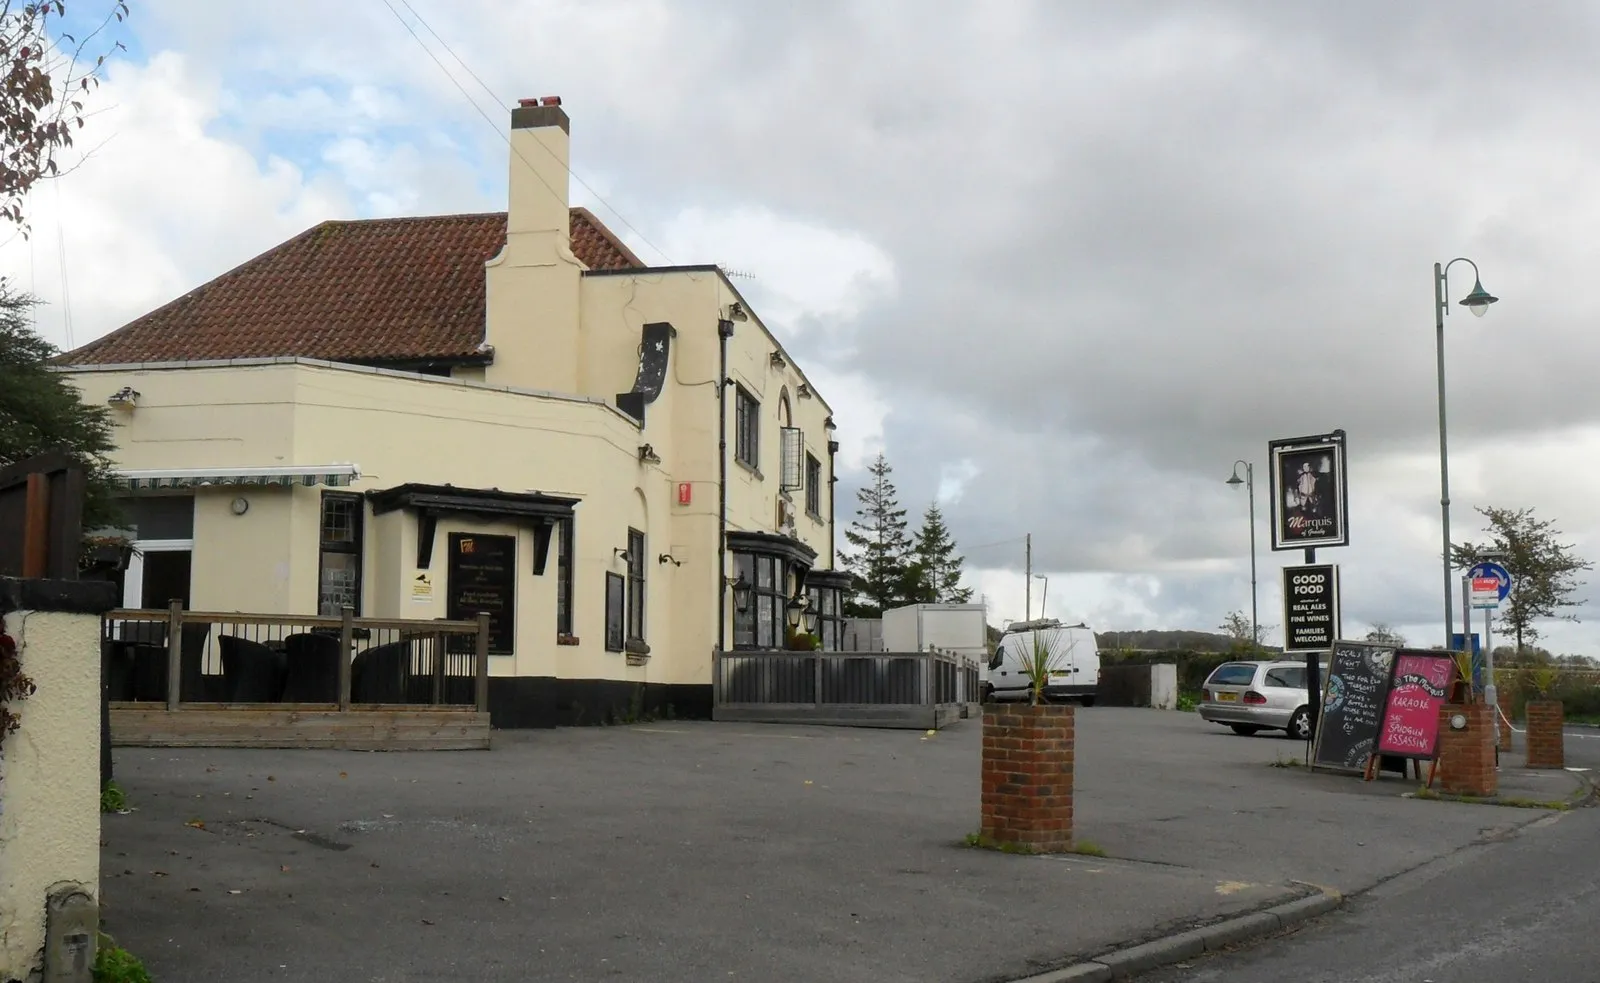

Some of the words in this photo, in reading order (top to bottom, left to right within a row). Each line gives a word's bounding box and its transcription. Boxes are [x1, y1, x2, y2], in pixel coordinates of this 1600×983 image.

[1288, 516, 1332, 529] Marquis
[1293, 575, 1325, 585] GOOD
[1294, 585, 1324, 595] FOOD
[1294, 635, 1328, 643] WELCOME
[1337, 658, 1361, 667] NIGHT
[1403, 674, 1417, 683] The
[1419, 678, 1444, 697] Marquis
[1392, 696, 1430, 710] KARAOKE
